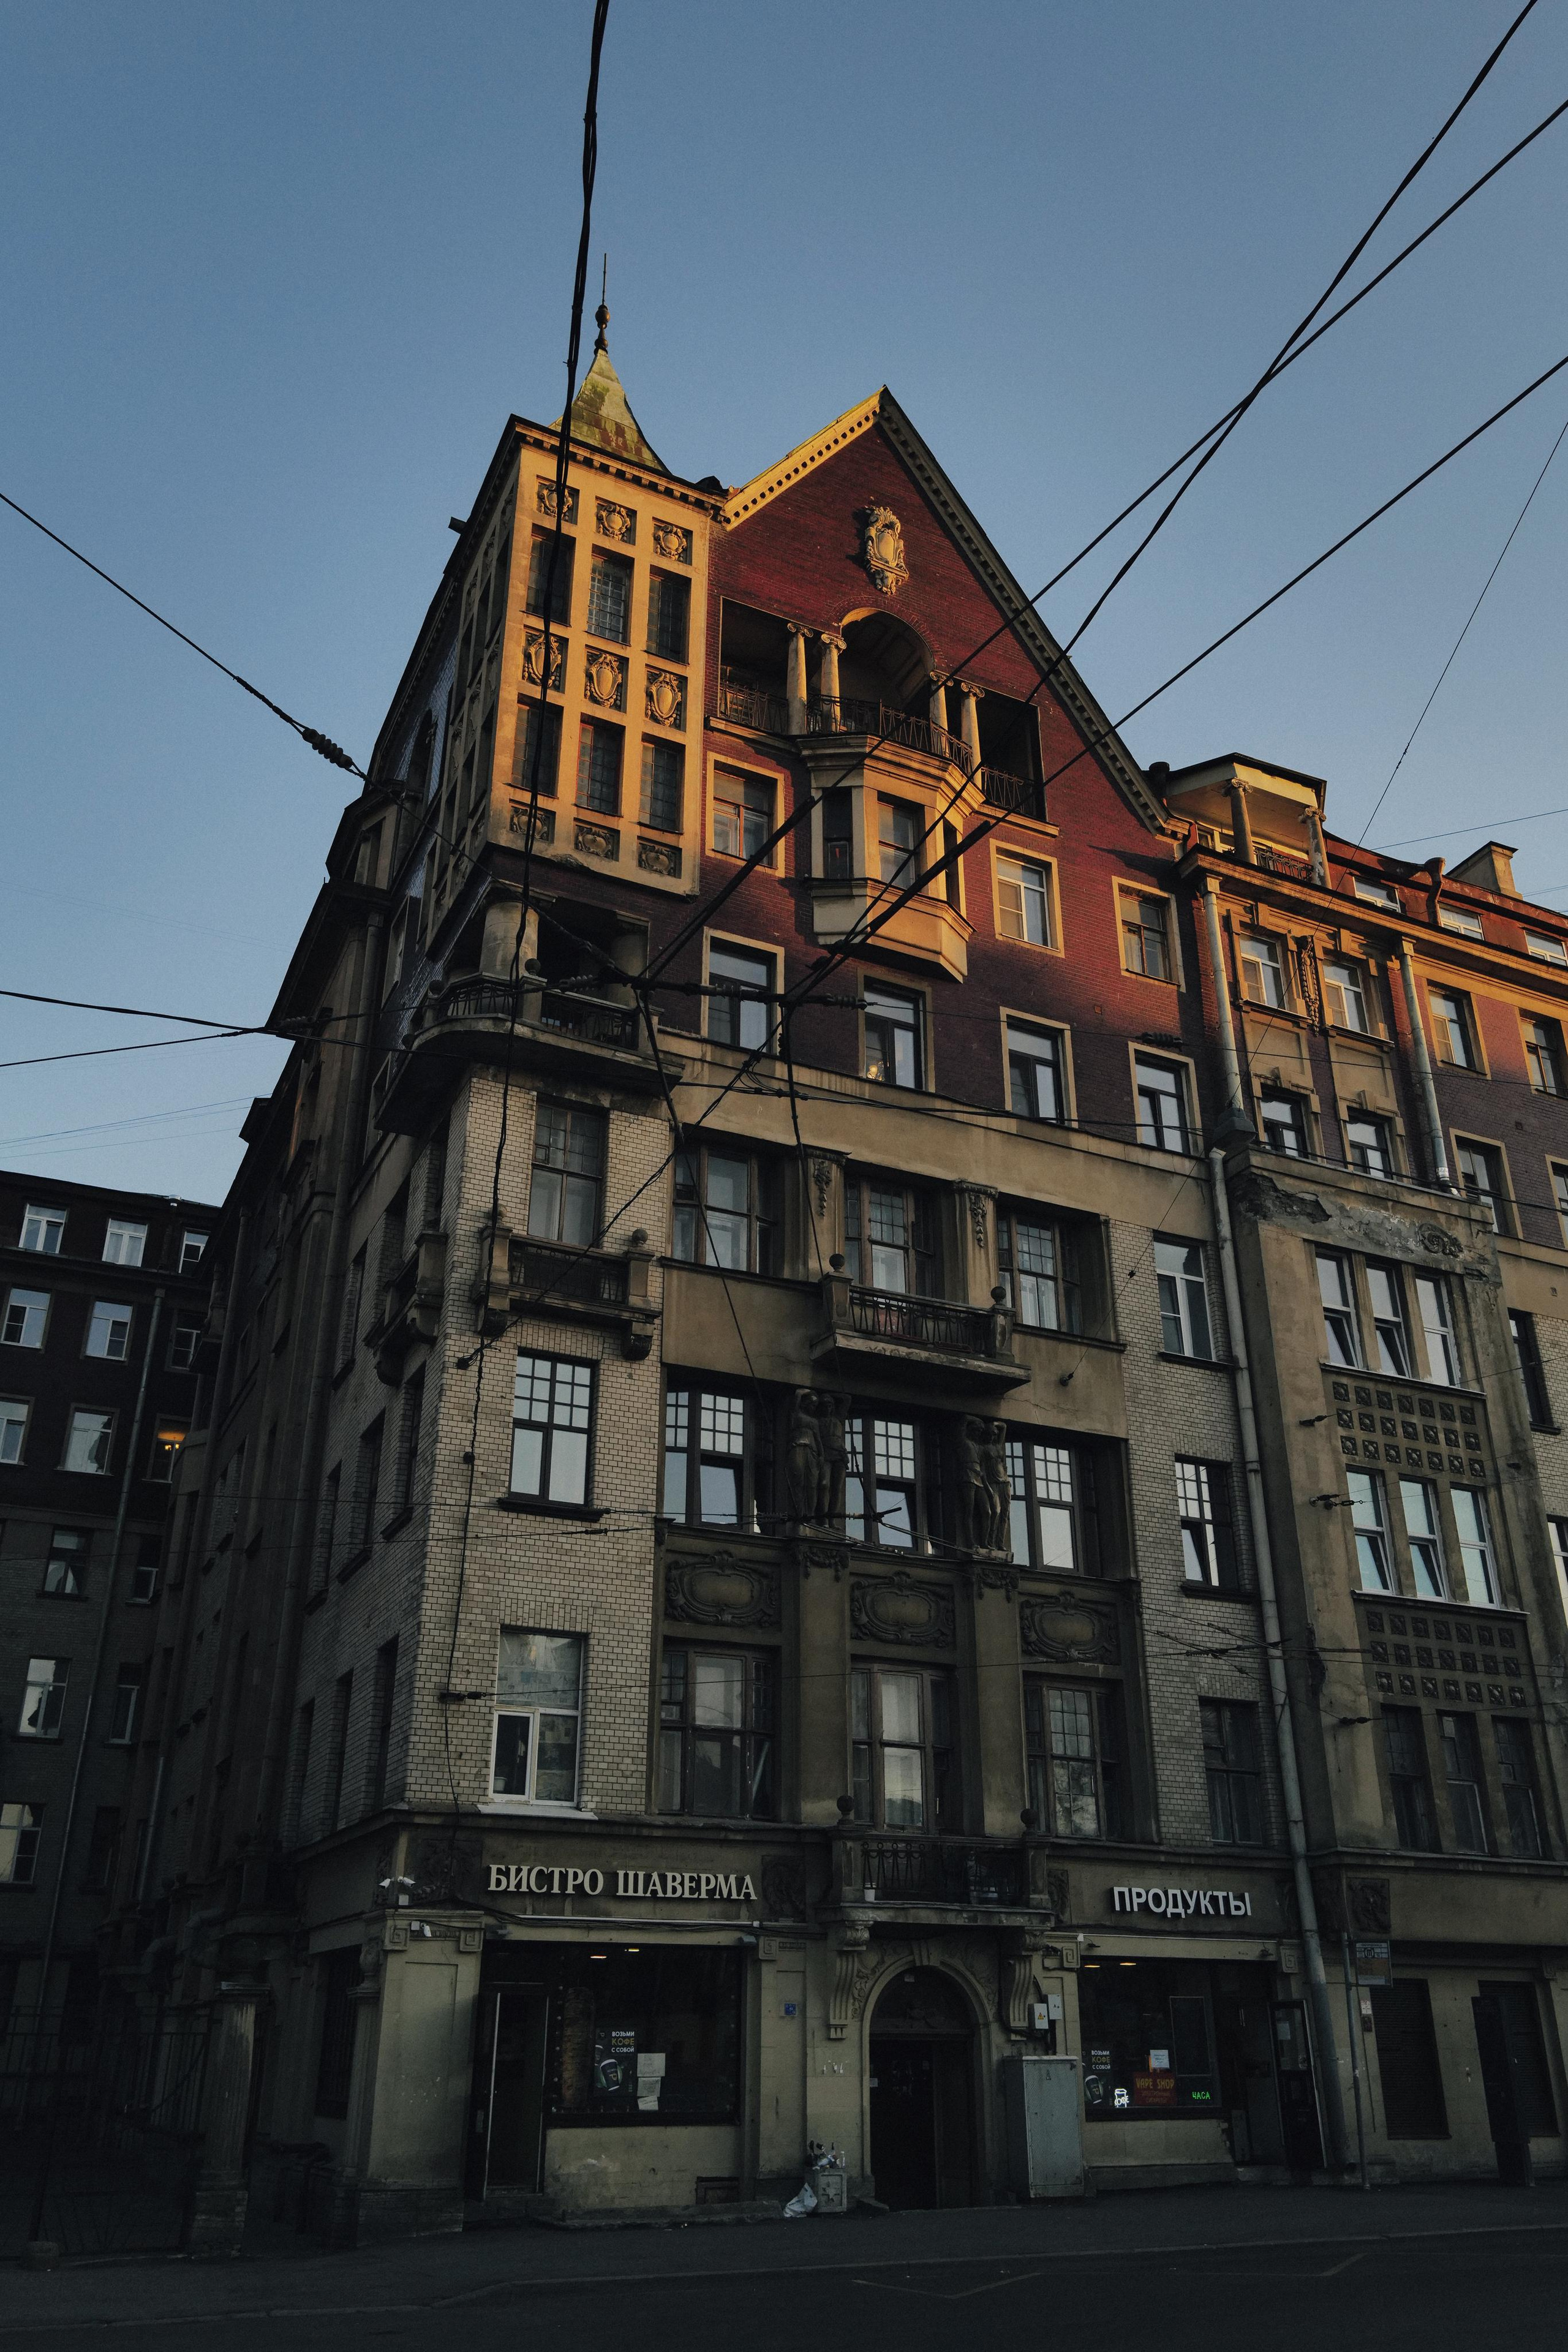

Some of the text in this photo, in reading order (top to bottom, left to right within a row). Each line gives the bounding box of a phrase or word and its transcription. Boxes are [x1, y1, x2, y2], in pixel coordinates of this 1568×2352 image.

[488, 1864, 758, 1899] БИСТРО ШАВЕРМА
[1114, 1887, 1252, 1918] ПРОДУКТЫ
[1136, 2078, 1175, 2089] VAPE SHOP
[1114, 2095, 1129, 2108] КОФЕ
